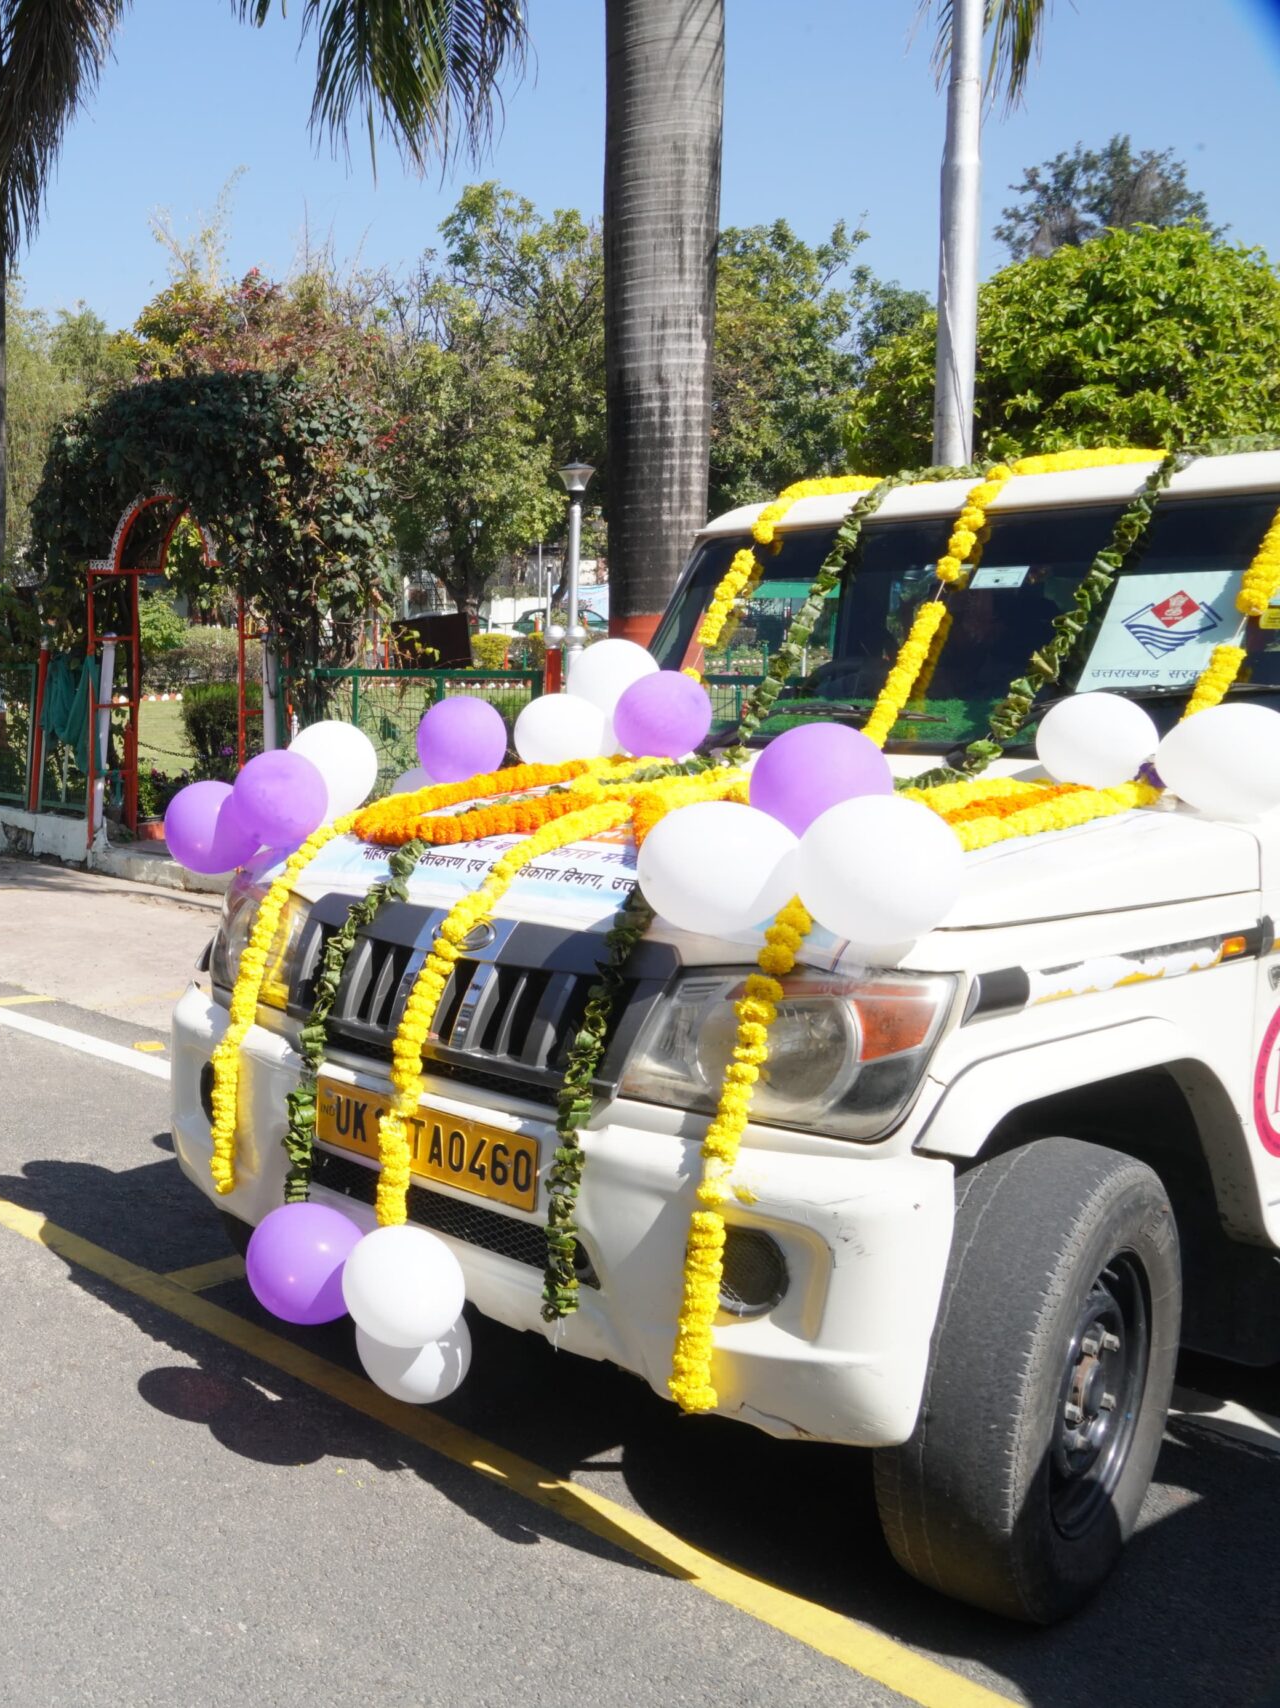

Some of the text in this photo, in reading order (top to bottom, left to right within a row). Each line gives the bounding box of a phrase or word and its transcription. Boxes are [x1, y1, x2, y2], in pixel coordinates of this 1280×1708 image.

[1091, 669, 1160, 679] उत्तराखण्ड
[465, 858, 491, 873] एवं
[558, 867, 605, 890] विभाग,
